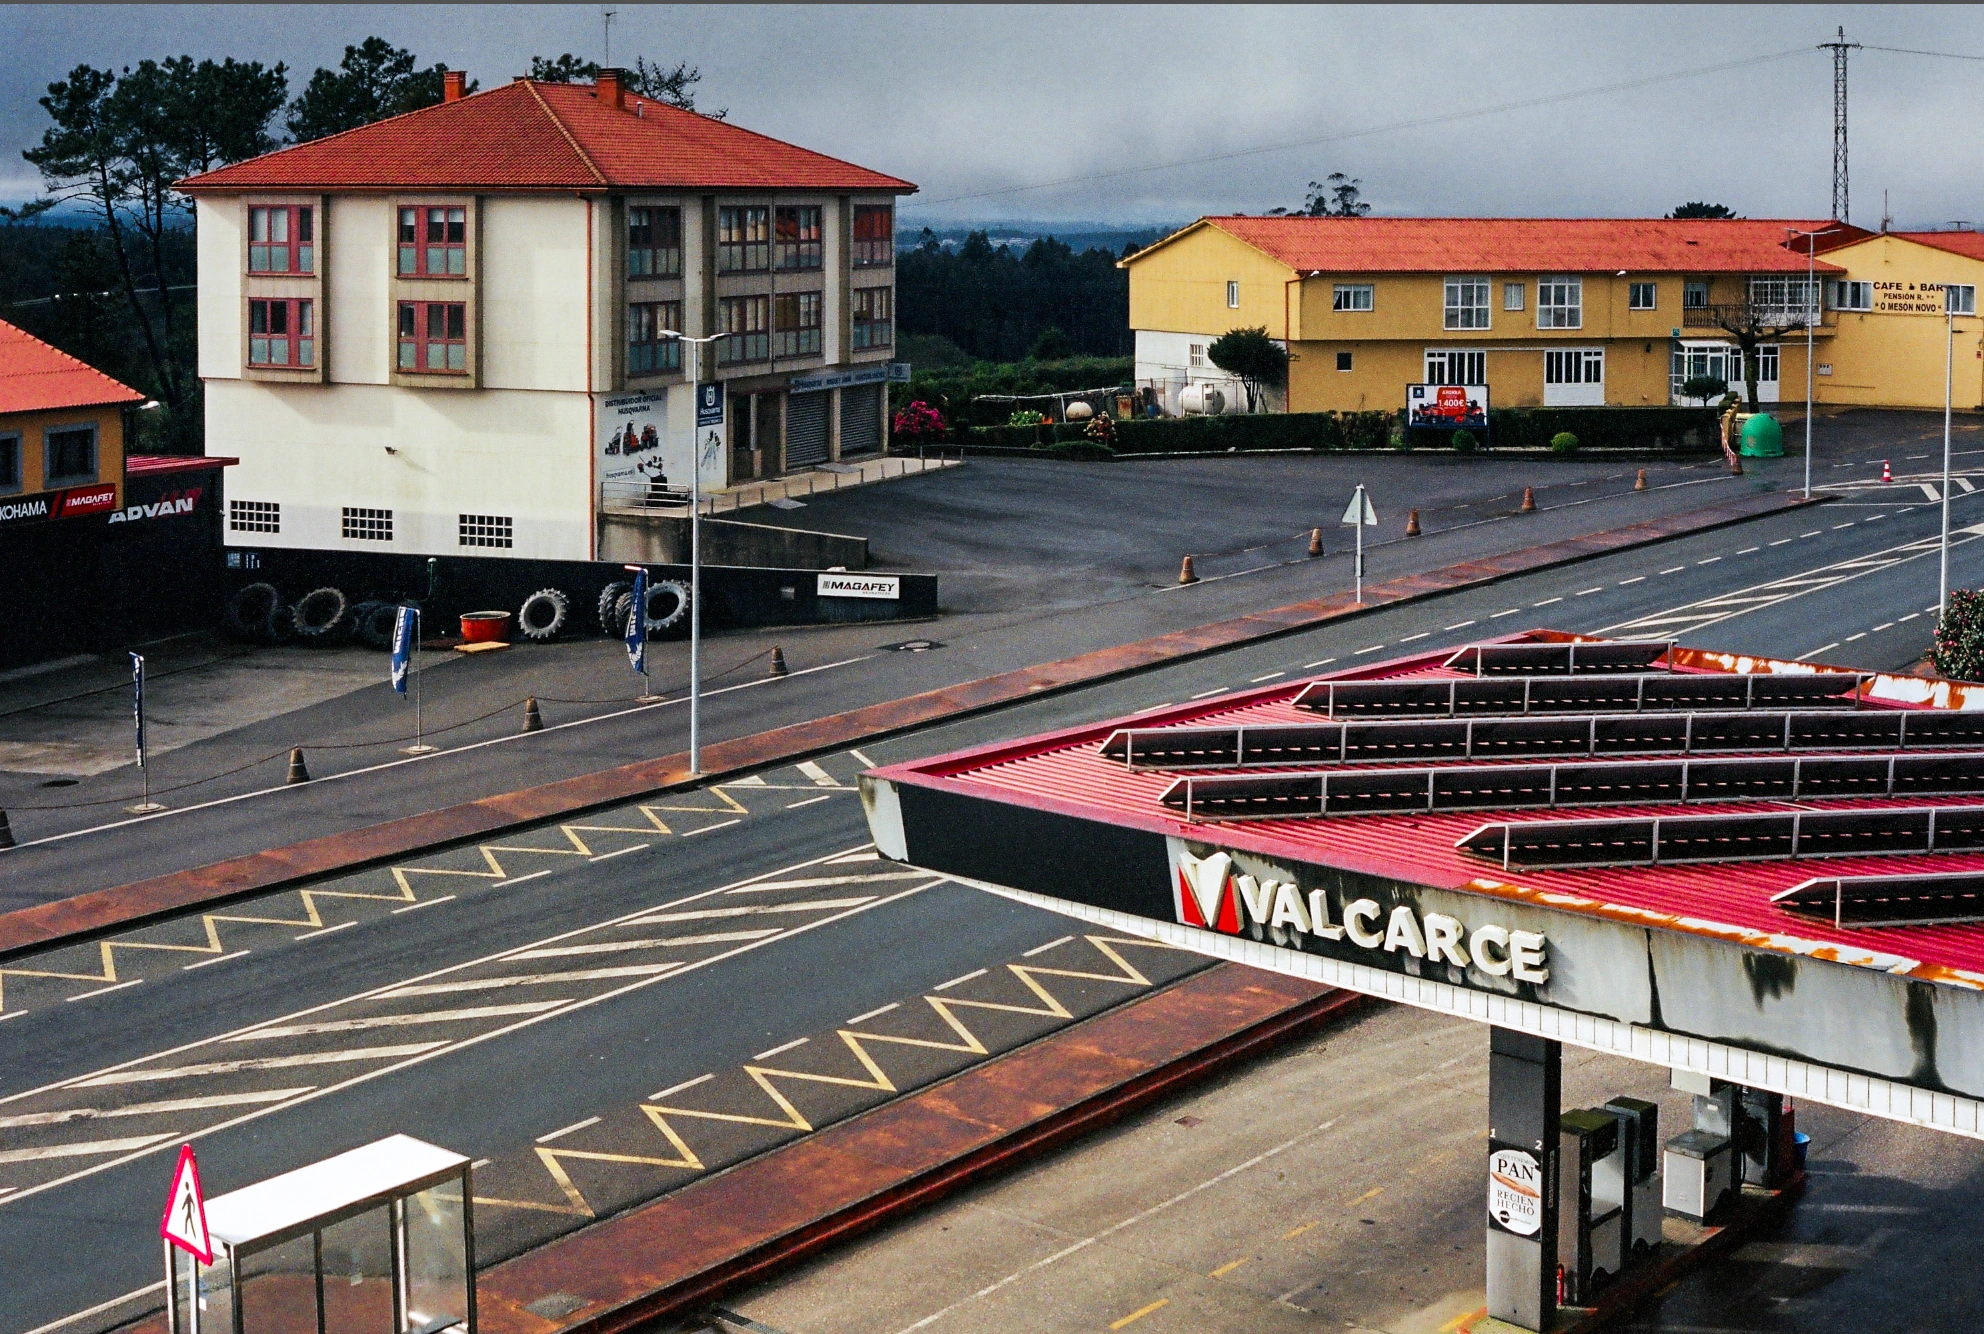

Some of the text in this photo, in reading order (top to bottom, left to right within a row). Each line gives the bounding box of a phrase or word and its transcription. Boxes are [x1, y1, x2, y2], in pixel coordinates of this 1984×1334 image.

[1873, 281, 1944, 292] CAFE BAR
[1915, 303, 1937, 312] NOVO
[617, 404, 651, 415] HUSQVARNA
[71, 492, 114, 507] MAGAFEY
[107, 497, 193, 525] ADVAN
[830, 581, 895, 592] MAGAFEY
[1237, 874, 1549, 985] VALCARCE
[1535, 1140, 1542, 1150] 2
[1496, 1158, 1534, 1182] PAN
[1497, 1198, 1535, 1216] HECHO
